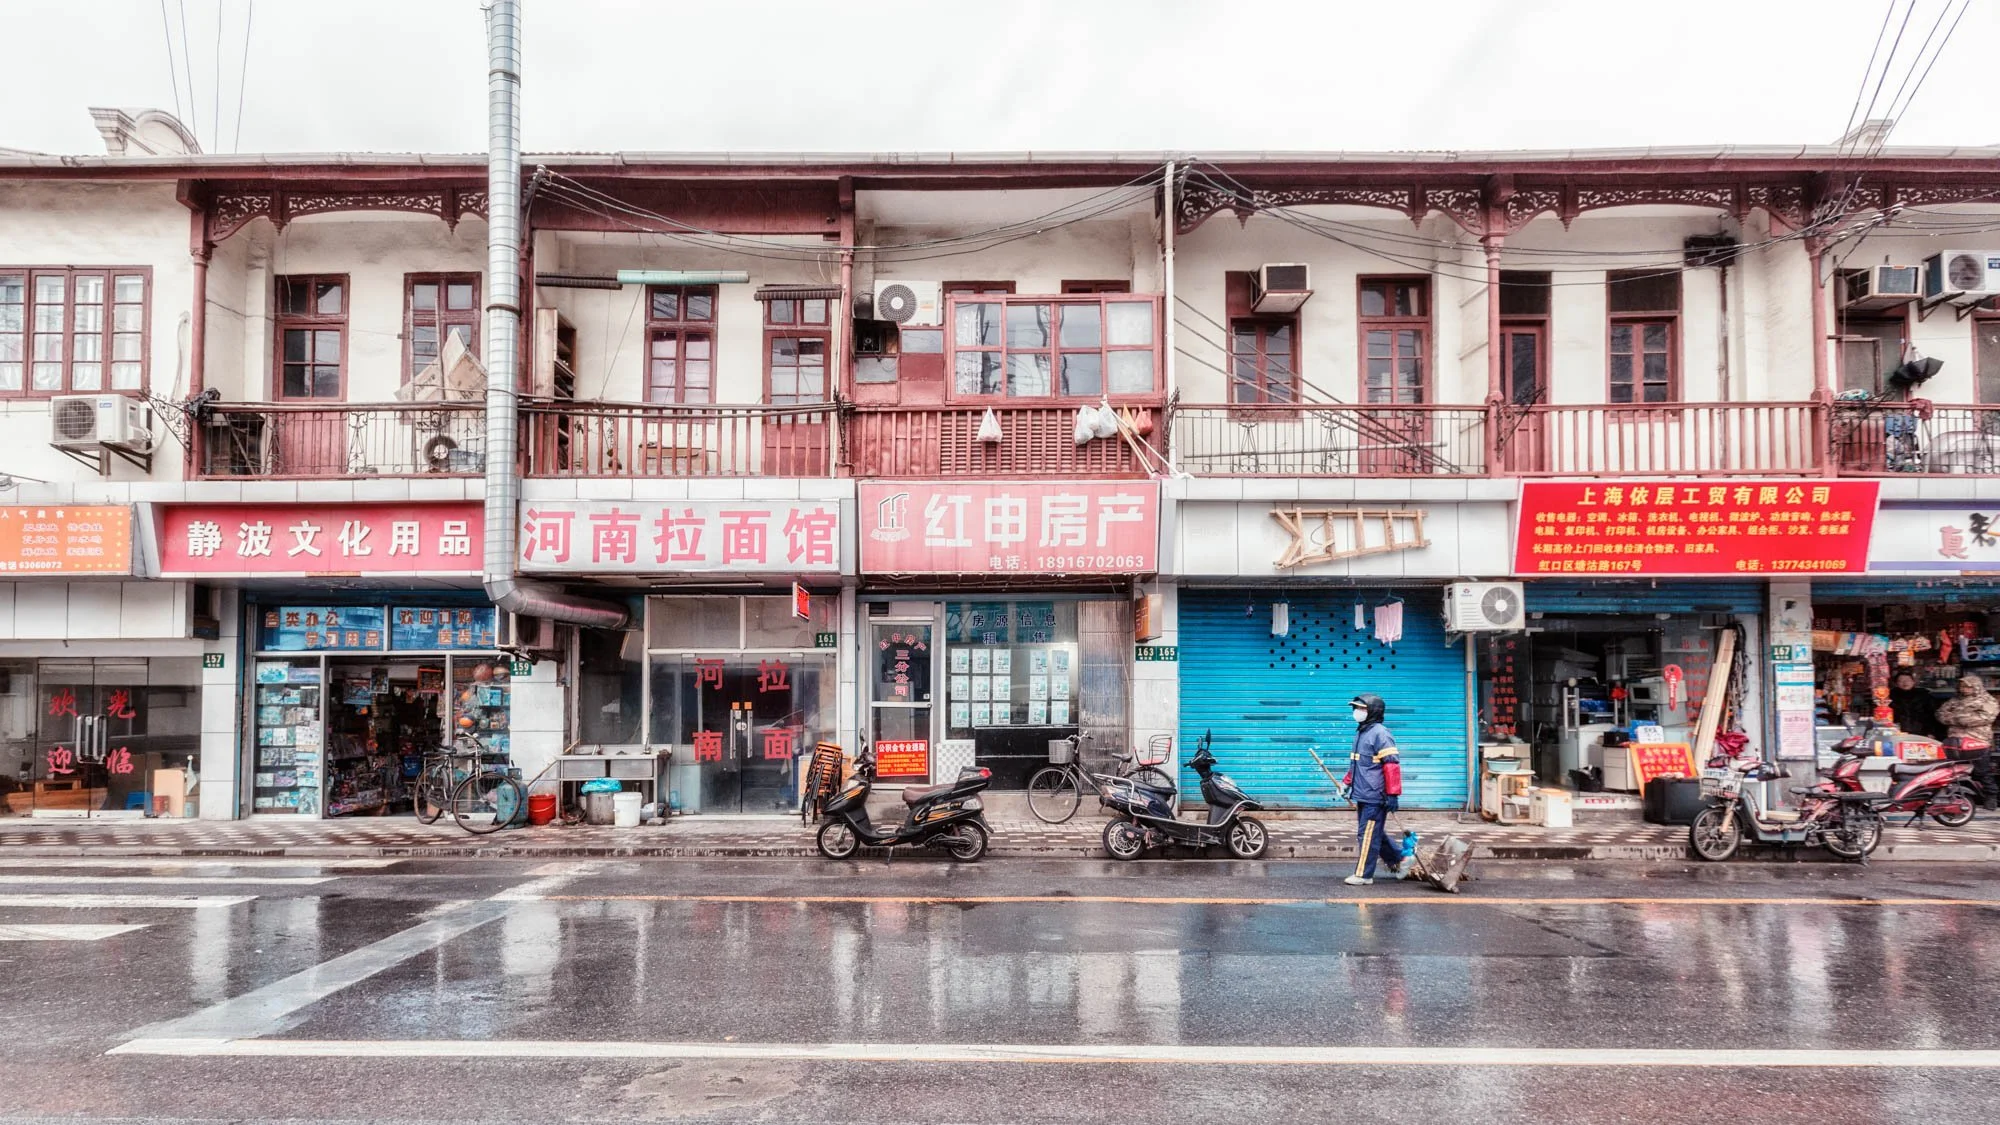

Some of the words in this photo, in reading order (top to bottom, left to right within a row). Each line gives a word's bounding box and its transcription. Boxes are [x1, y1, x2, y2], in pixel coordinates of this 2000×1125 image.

[1577, 486, 1831, 506] 上海依层工贸有限公司
[924, 493, 1145, 548] 红申房产
[187, 520, 472, 558] 静波文化用品
[523, 507, 837, 565] 河南拉面馆
[1037, 556, 1144, 569] 18916702063
[265, 611, 340, 628] 各类办公
[400, 609, 473, 626] 欢迎订购
[972, 612, 1056, 627] 房源信息
[305, 630, 382, 647] 学习用品
[818, 634, 834, 643] 161
[206, 654, 222, 663] 157
[1138, 648, 1154, 657] 163
[1159, 648, 1175, 657] 165
[1773, 647, 1791, 656] 167
[512, 662, 529, 671] 159
[894, 649, 911, 697] 三分公司
